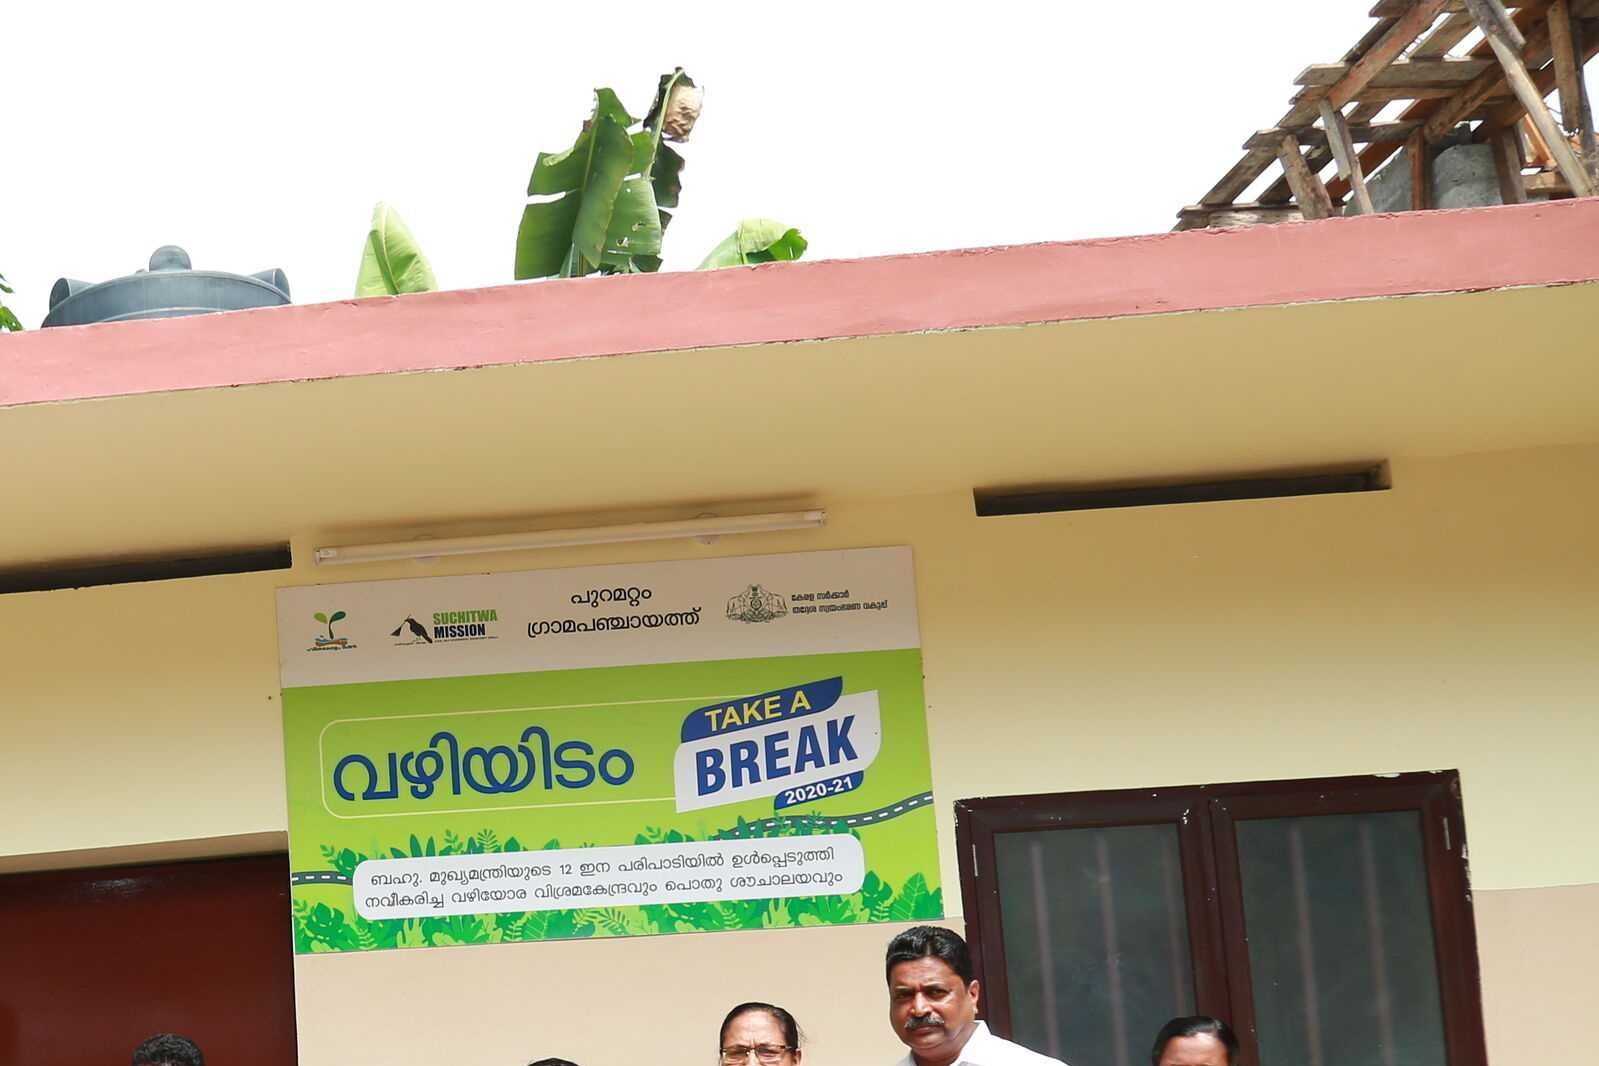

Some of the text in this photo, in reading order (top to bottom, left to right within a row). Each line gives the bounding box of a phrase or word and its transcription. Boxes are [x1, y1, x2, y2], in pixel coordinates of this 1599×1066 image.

[571, 587, 652, 608] പുറമറ്റം
[432, 608, 498, 626] SUCHITWA
[433, 623, 486, 639] MISSION
[527, 606, 702, 639] ഗ്രാമപഞ്ചായത്ത്
[704, 689, 811, 732] TAKE A
[333, 725, 635, 802] വഴിയിടം
[696, 714, 859, 797] BREAK
[784, 777, 854, 806] 2020-21
[370, 847, 835, 887] ബഹു. മുഖ്യമന്ത്രിയുടെ 12 ഇന പരിപാടിയിൽ ഉൾപ്പെടുത്തി
[365, 890, 445, 908] നവീകരിച്ച
[451, 888, 527, 904] വഴിയോര
[534, 879, 658, 899] വിശ്രമകേന്ദ്രവും
[665, 878, 723, 893] പൊതു
